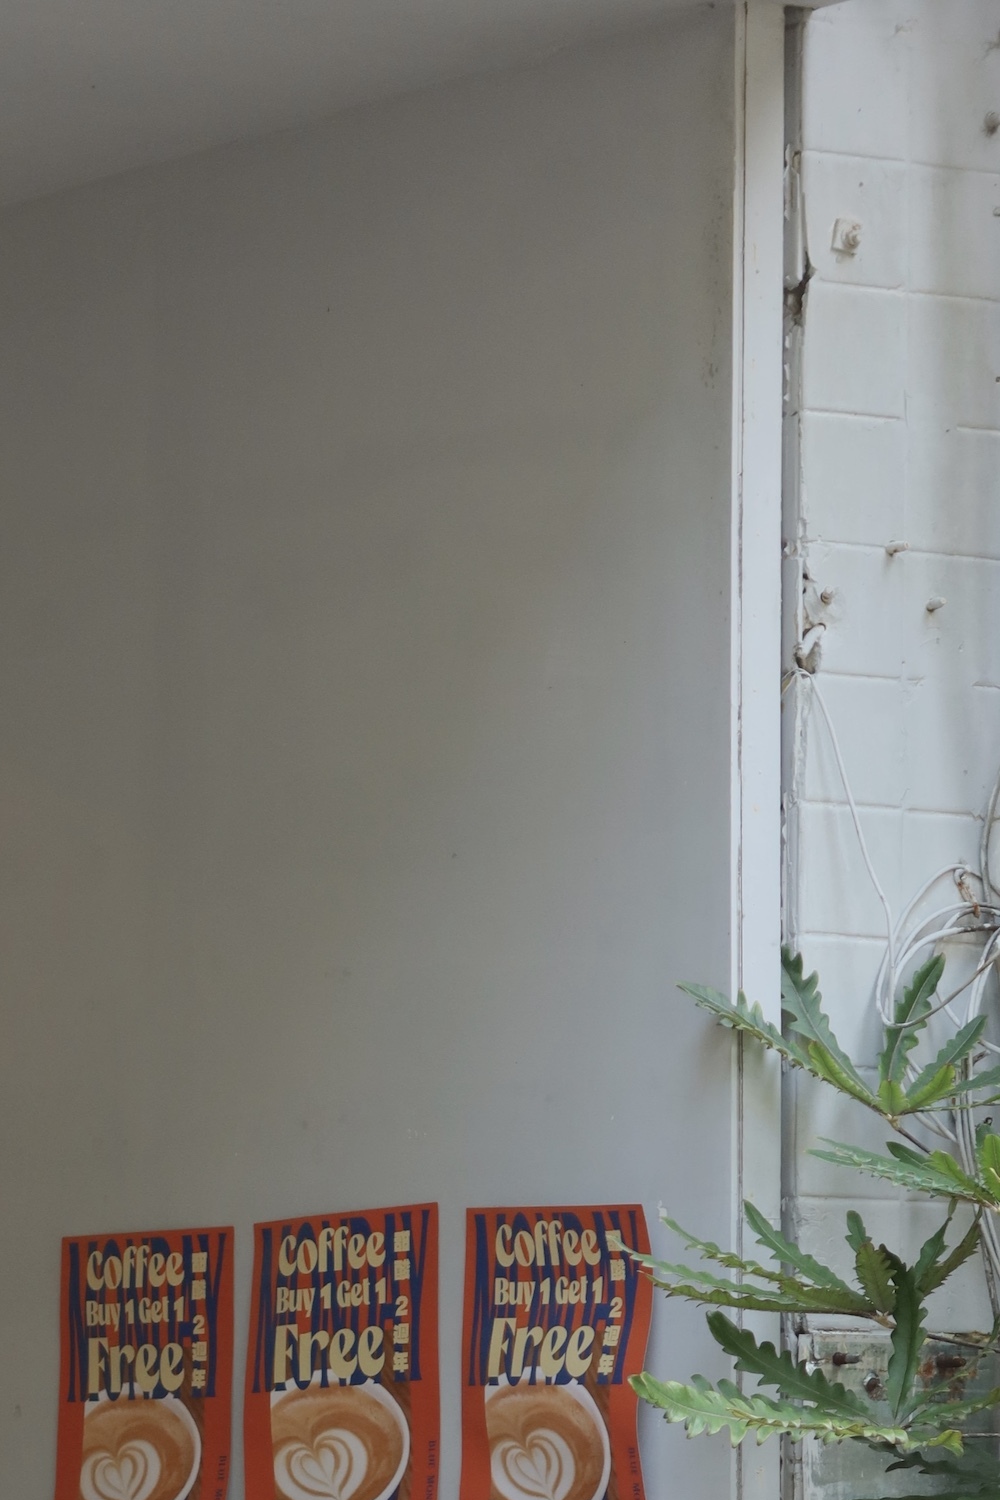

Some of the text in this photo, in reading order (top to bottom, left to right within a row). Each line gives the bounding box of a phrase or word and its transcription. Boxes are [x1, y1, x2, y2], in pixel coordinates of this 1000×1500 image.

[279, 1226, 386, 1276] Coffee
[495, 1220, 601, 1267] Coffee
[87, 1245, 185, 1290] Coffee
[86, 1296, 185, 1332] Buy 1 Get 1
[276, 1277, 386, 1317] Buy 1 Get 1
[494, 1275, 603, 1312] Buy 1 Get 1
[88, 1337, 185, 1394] Free
[274, 1324, 385, 1383] Free
[488, 1317, 595, 1377] Free
